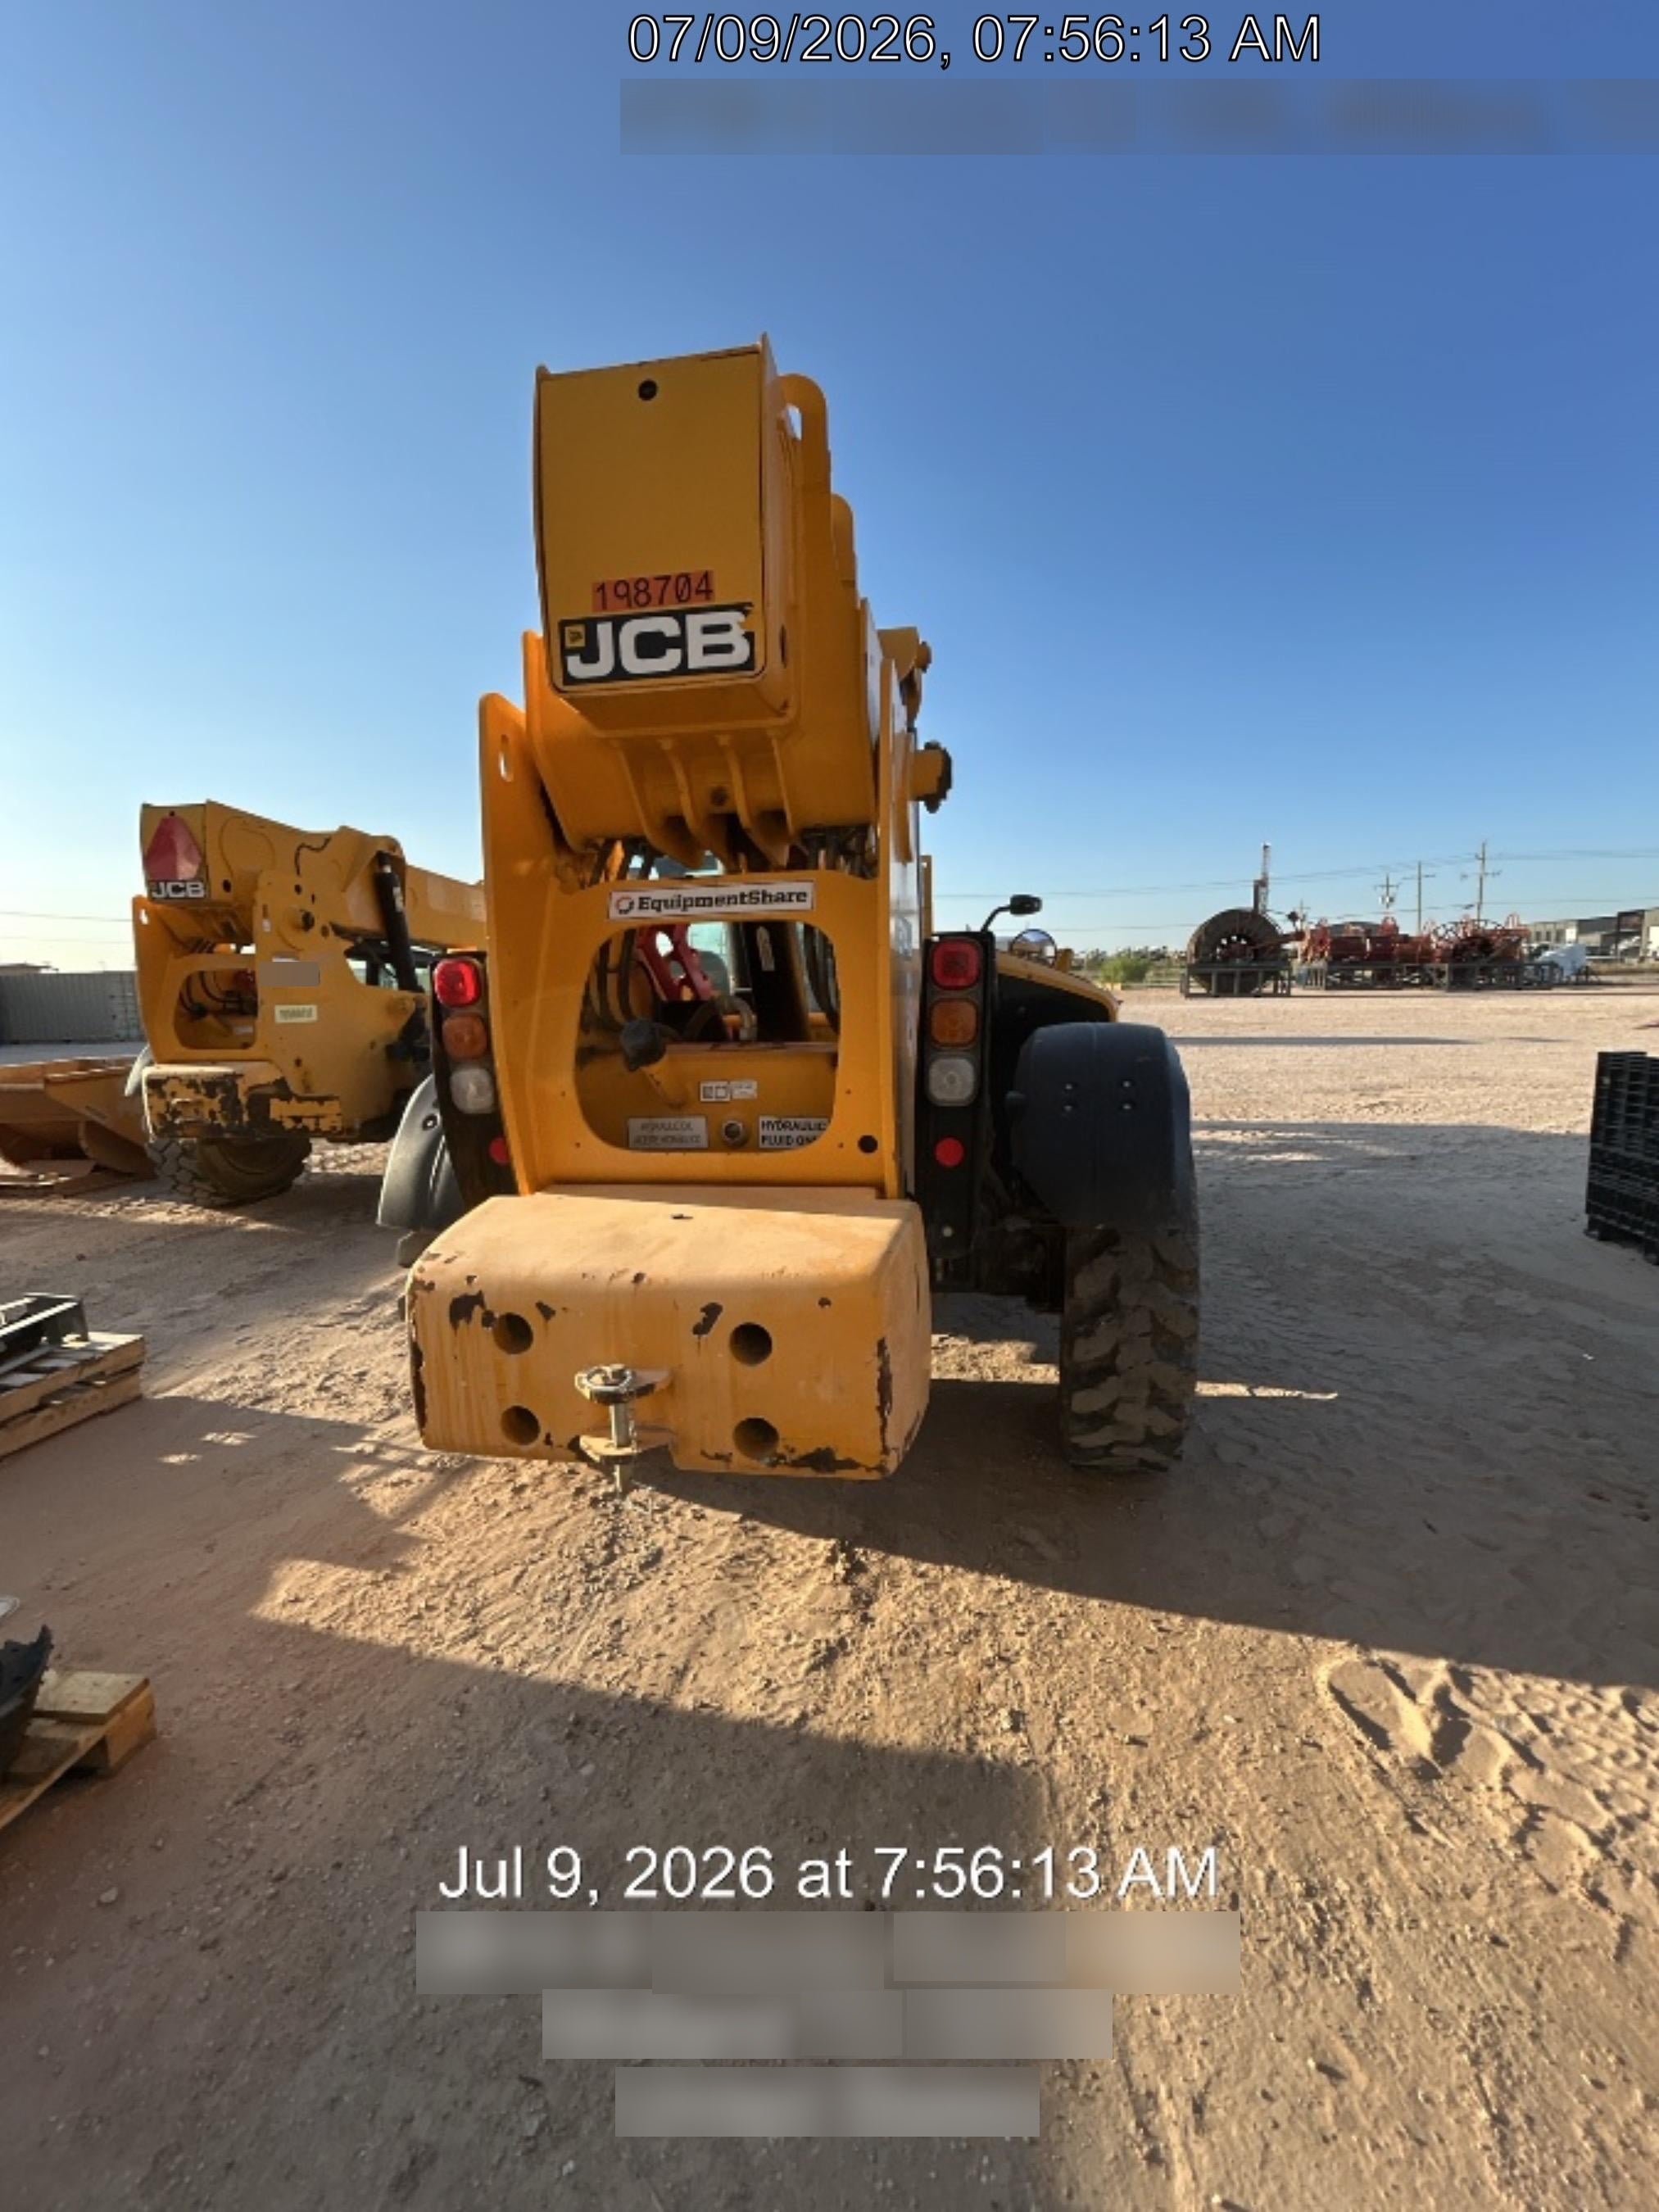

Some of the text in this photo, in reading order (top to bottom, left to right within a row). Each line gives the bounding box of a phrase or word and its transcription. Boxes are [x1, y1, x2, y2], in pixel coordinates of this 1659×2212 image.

[596, 570, 714, 610] 198704
[565, 611, 750, 679] JCB
[151, 881, 205, 899] JCB
[637, 888, 808, 913] EquipmentShare
